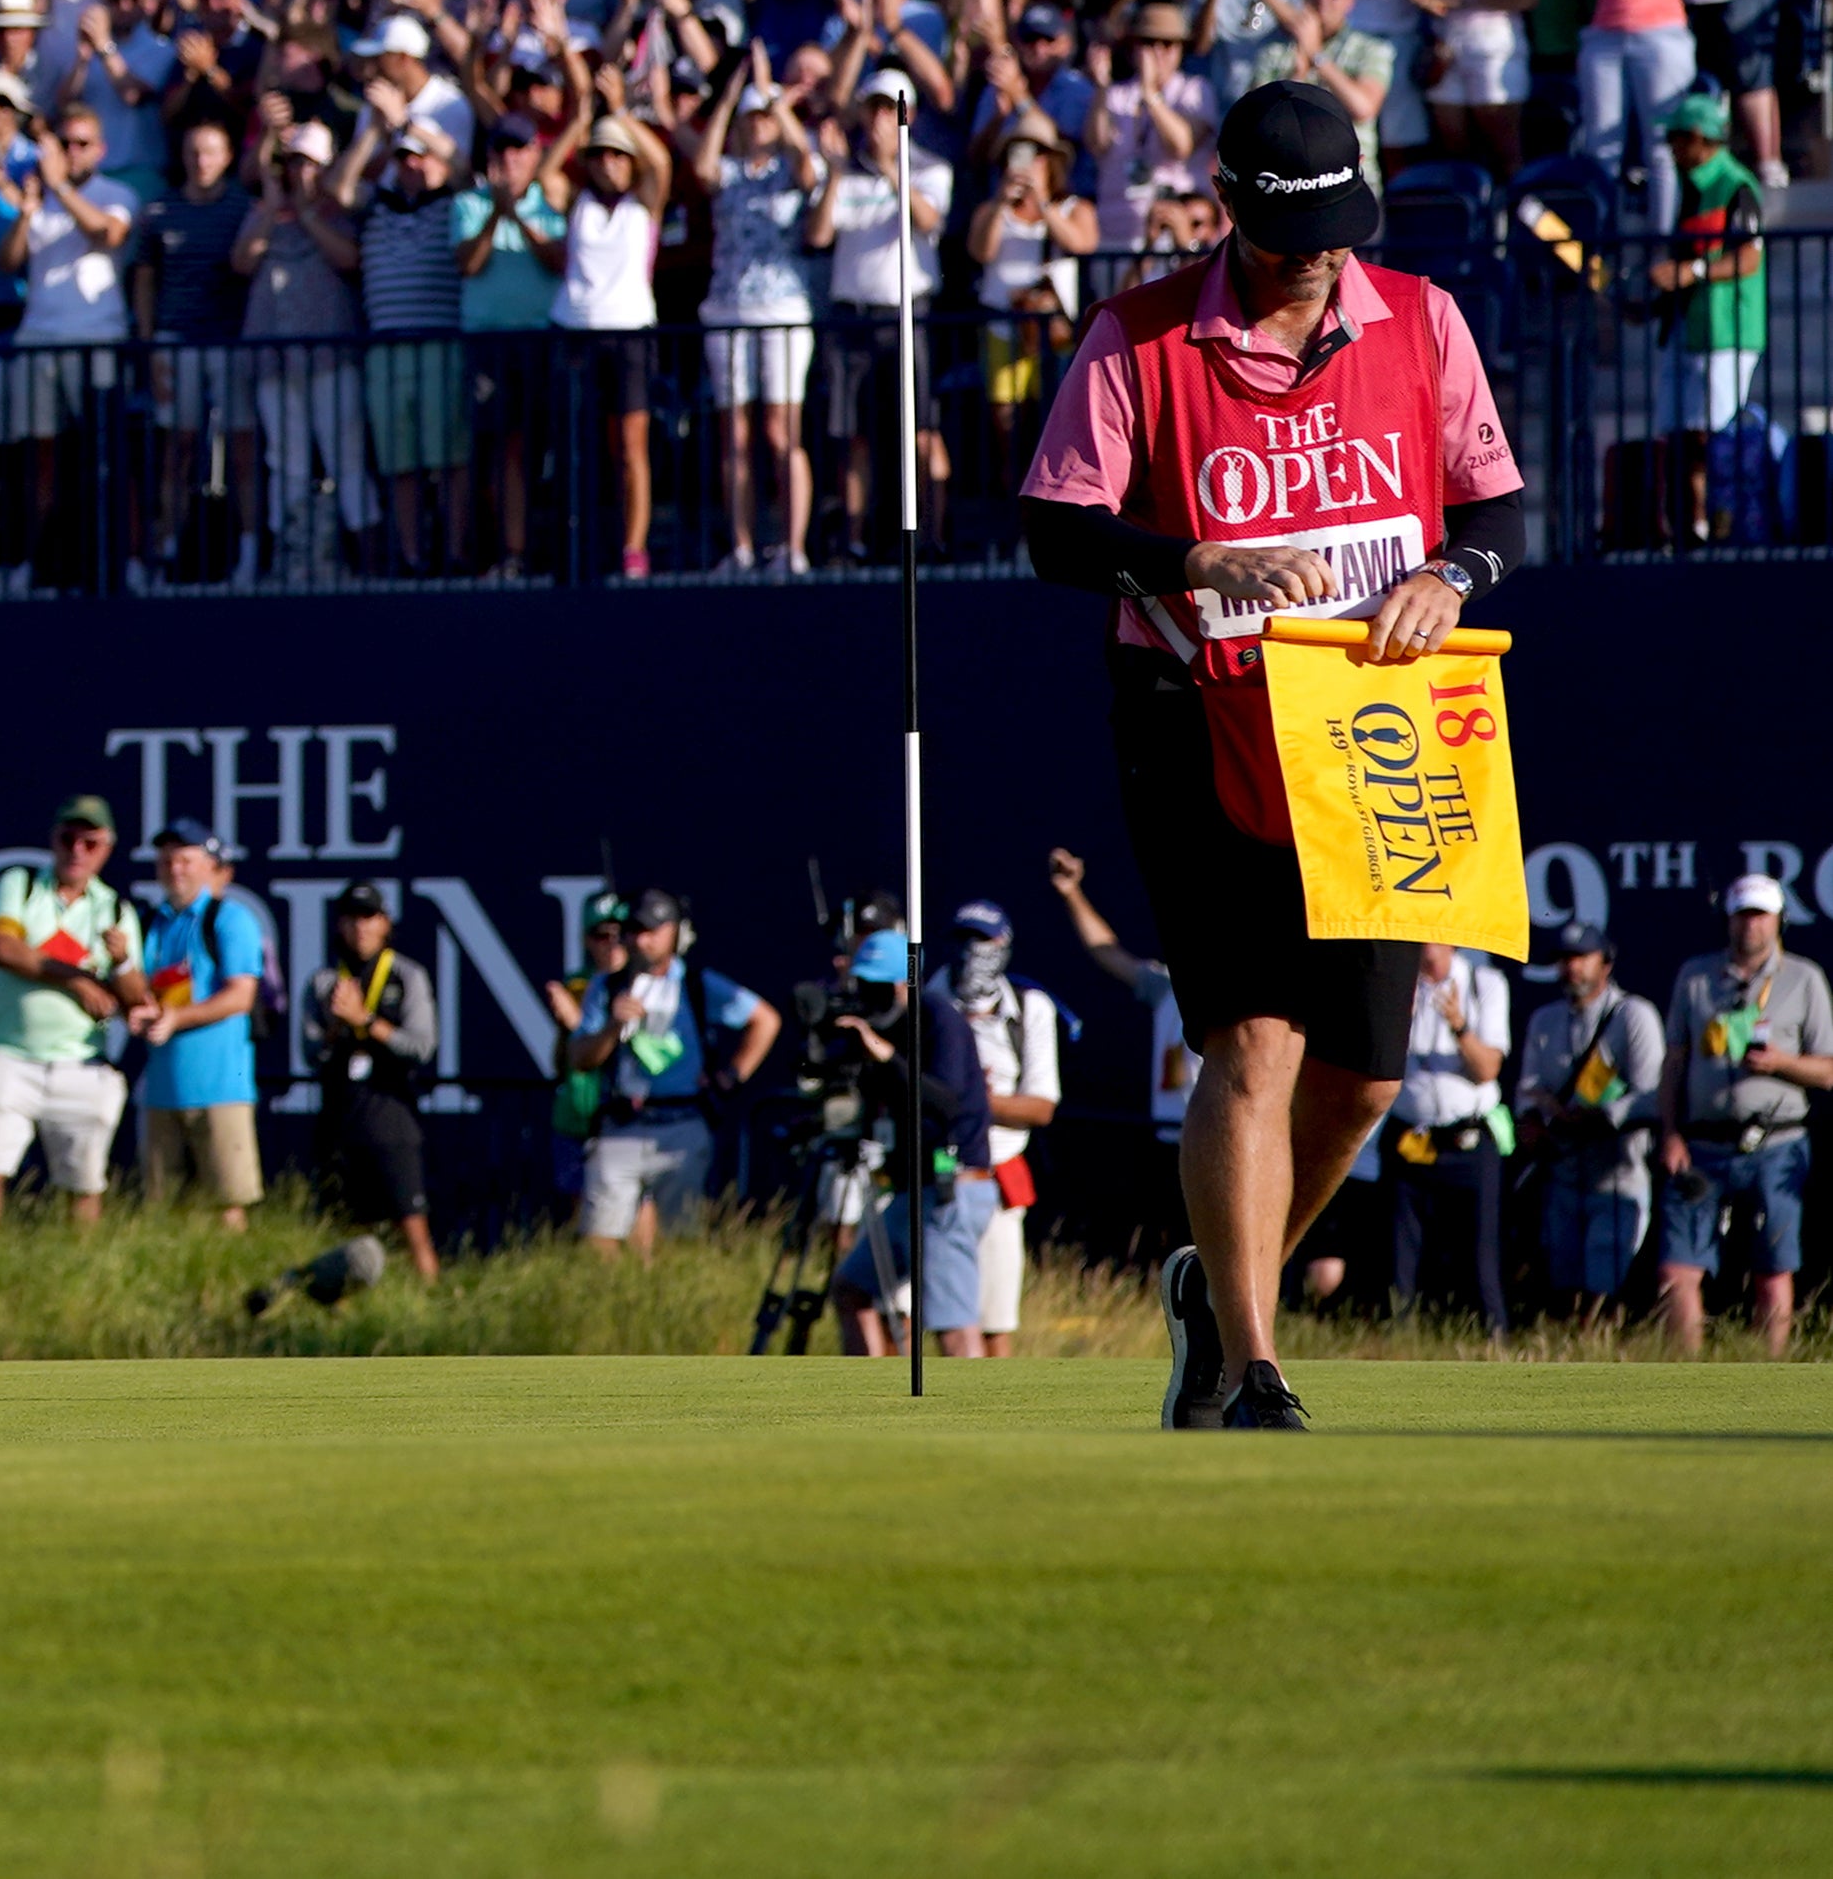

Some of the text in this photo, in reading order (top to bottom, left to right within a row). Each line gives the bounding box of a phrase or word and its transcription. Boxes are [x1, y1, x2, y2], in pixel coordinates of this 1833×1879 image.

[1255, 402, 1343, 450] THE
[1197, 432, 1403, 524] OPEN
[1429, 677, 1497, 747] 18
[105, 724, 404, 860] THE
[1326, 718, 1384, 893] 149TH ROYAL ST GEORGE'S
[1351, 702, 1453, 901] OPEN
[1424, 764, 1478, 847] THE
